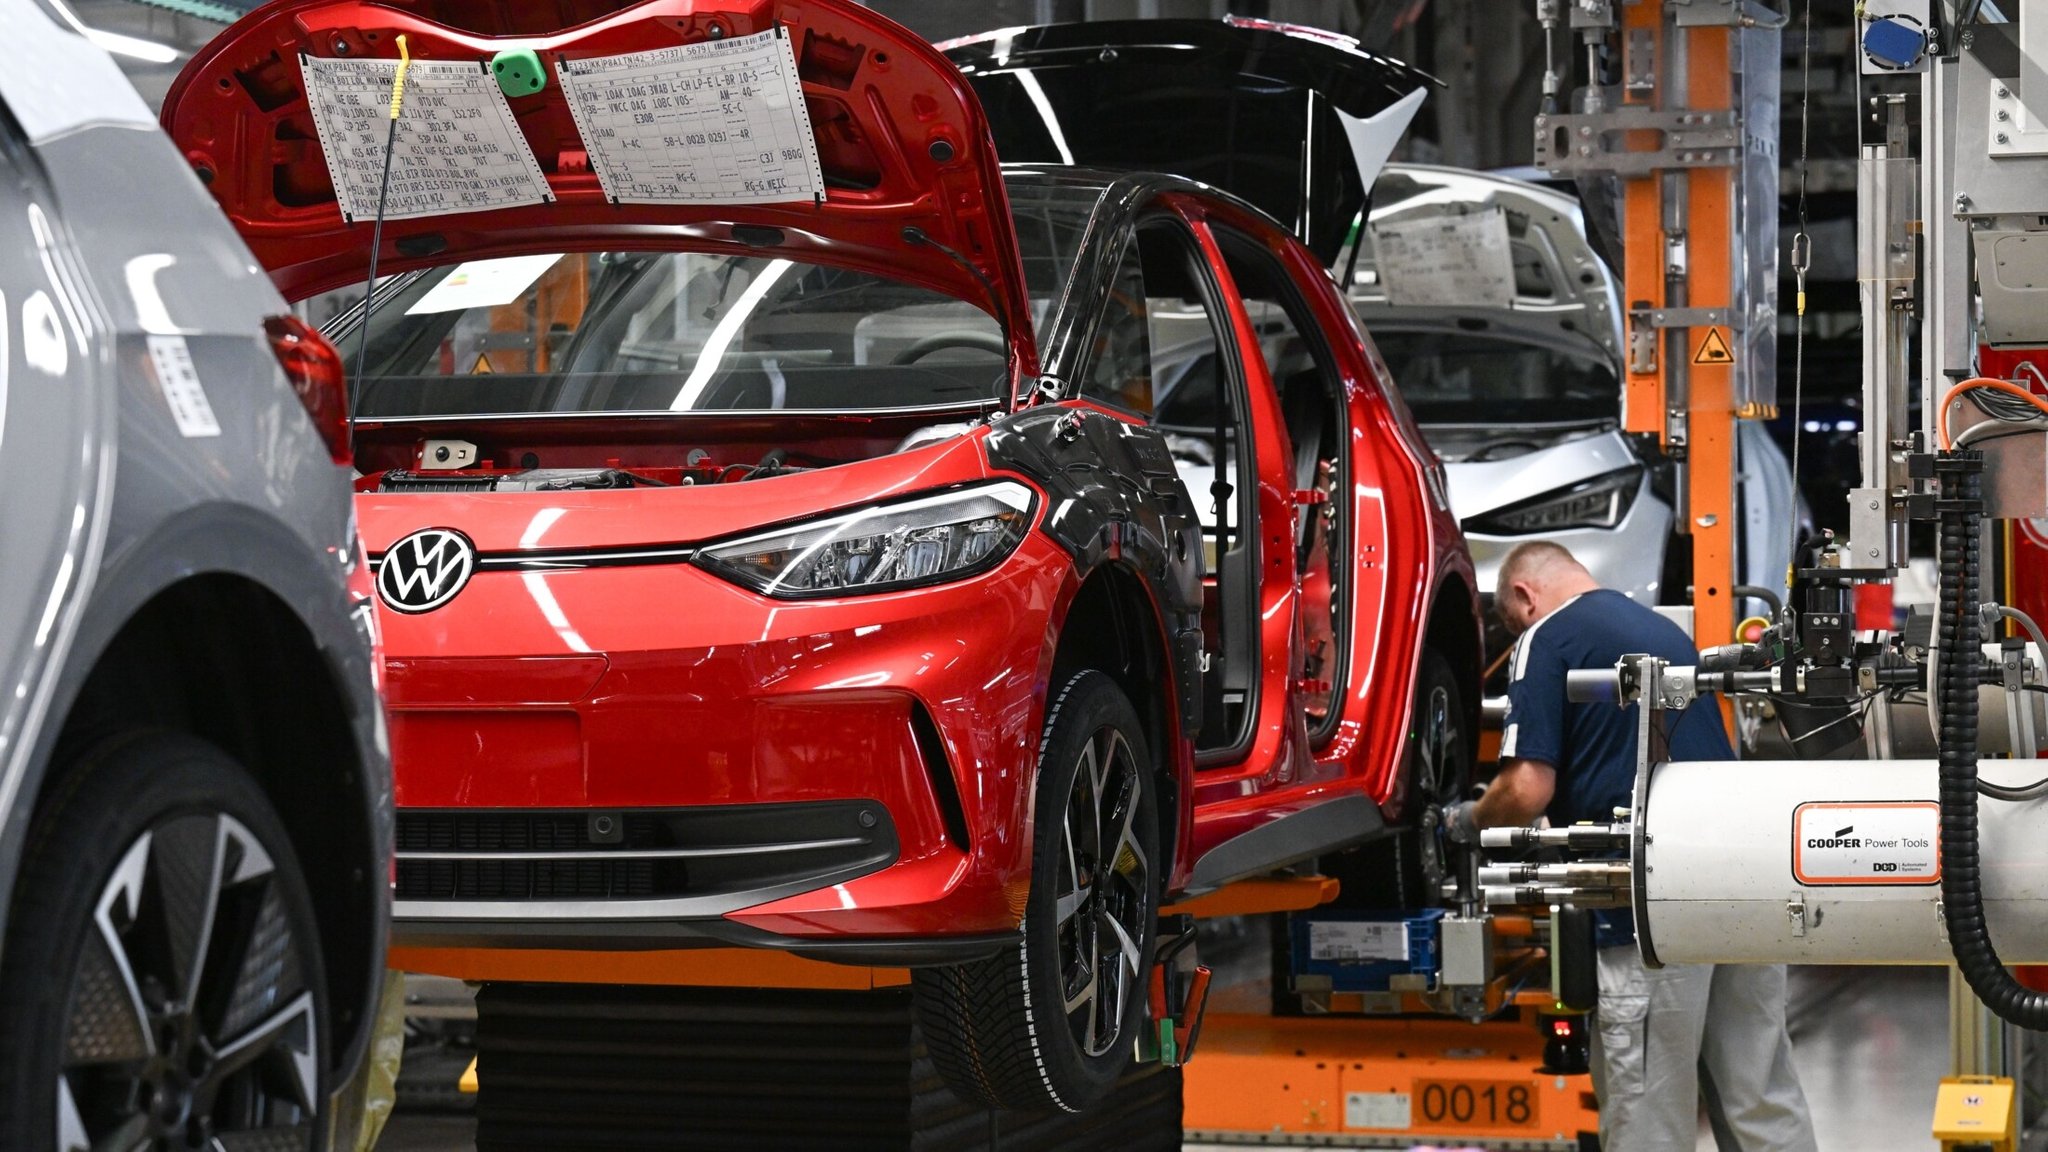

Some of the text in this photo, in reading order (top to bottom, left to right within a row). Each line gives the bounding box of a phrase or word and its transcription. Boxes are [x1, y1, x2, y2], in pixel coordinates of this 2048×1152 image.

[687, 45, 706, 55] 5679
[671, 80, 692, 92] L-CH
[693, 77, 714, 89] LP-E
[415, 157, 429, 165] 7E7
[379, 530, 471, 611] VW
[1807, 838, 1929, 848] COOPER Power Tools
[1422, 1083, 1531, 1124] 0018
